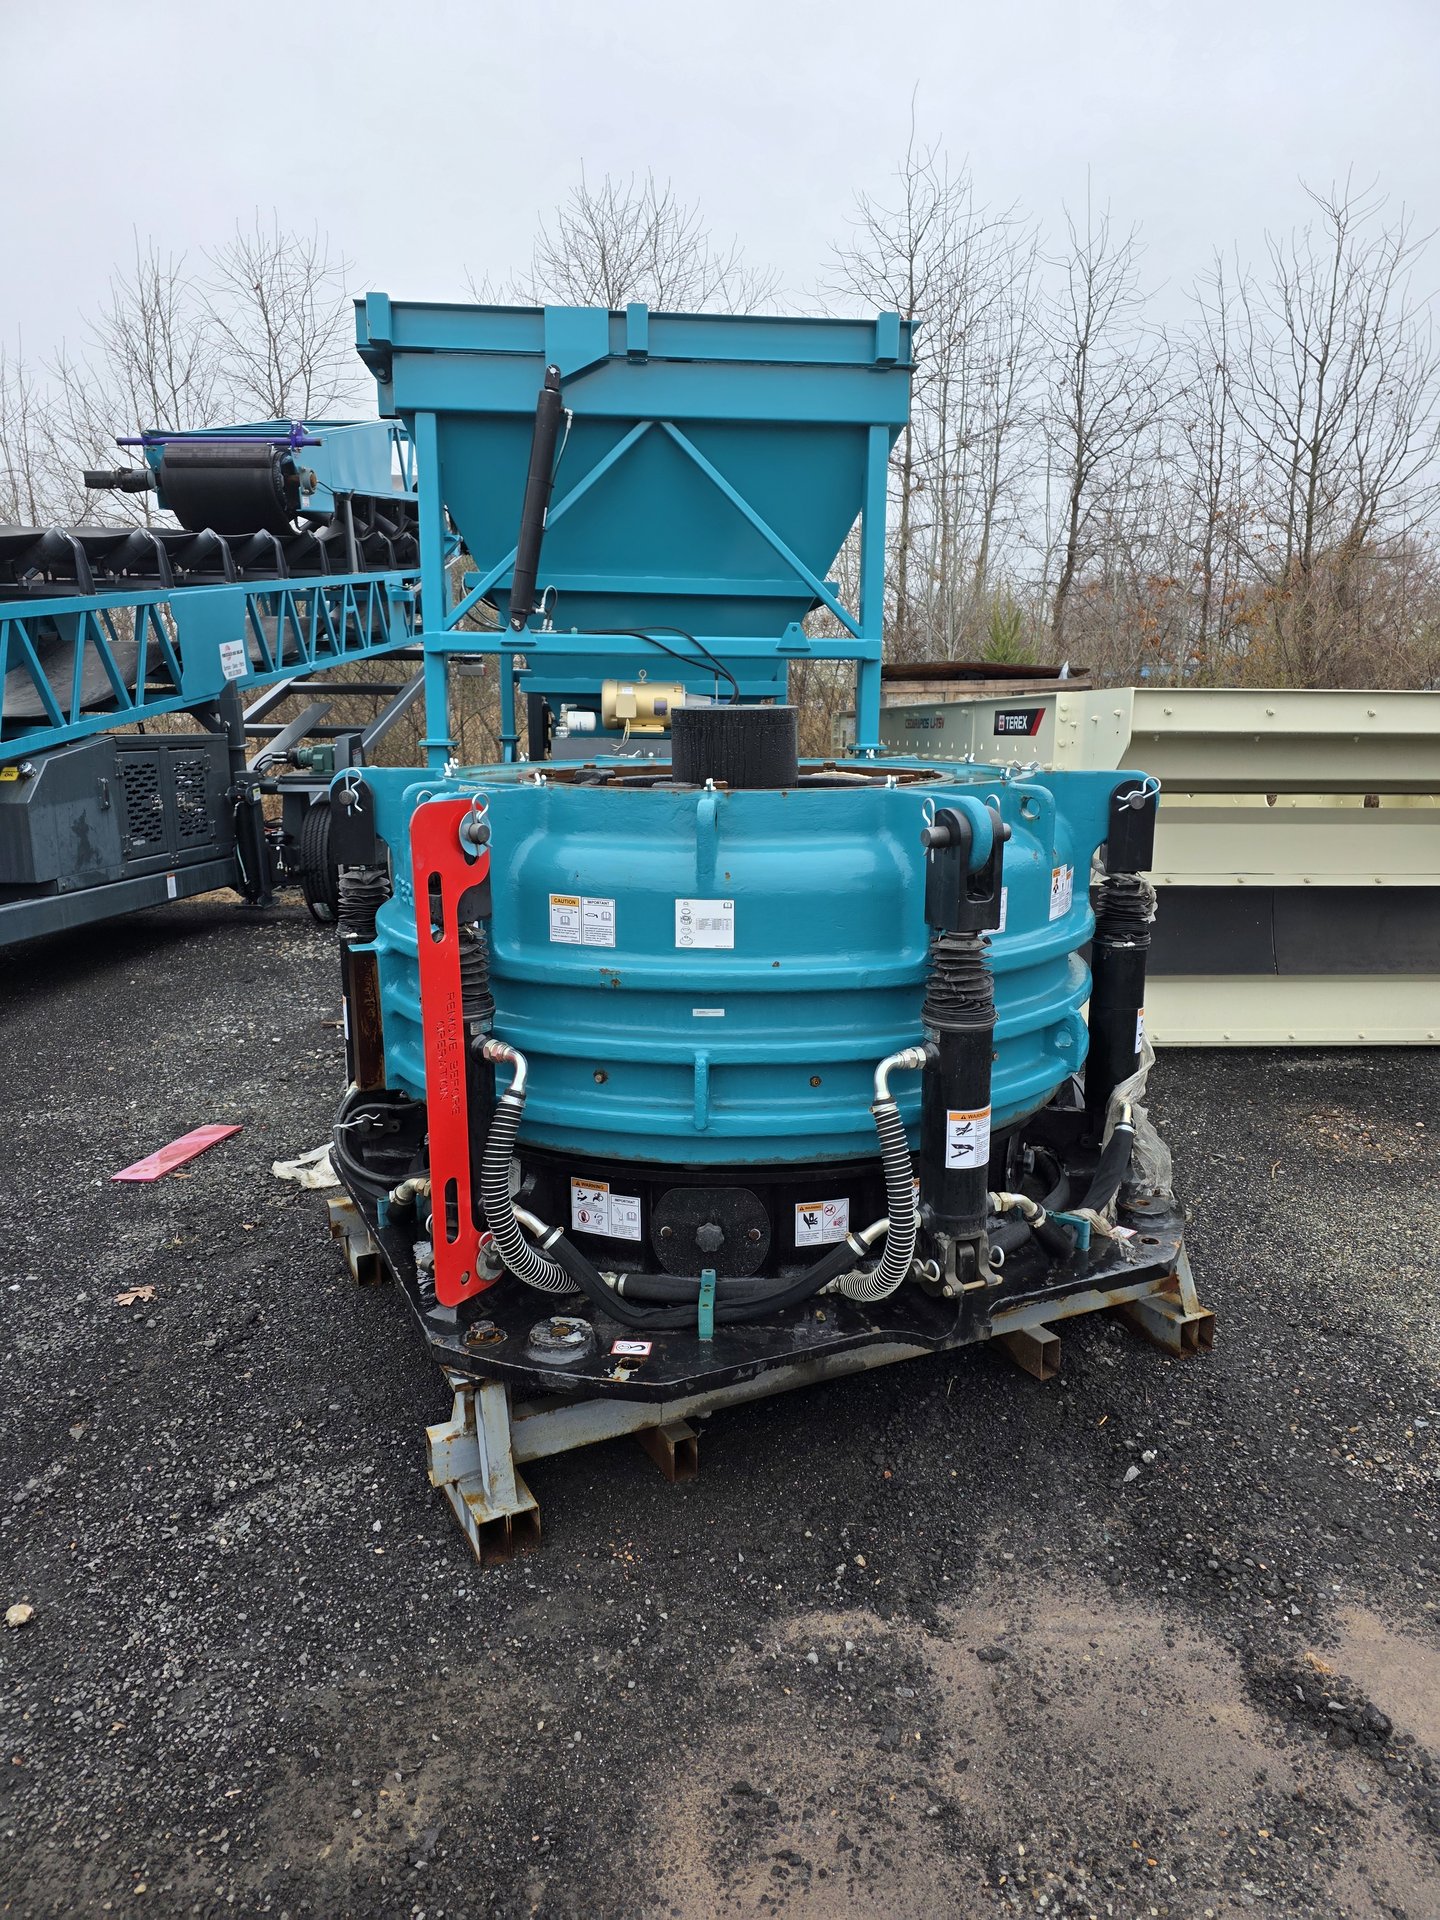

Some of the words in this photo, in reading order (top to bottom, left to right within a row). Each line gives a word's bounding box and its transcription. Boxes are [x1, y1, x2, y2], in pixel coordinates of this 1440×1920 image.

[1005, 715, 1028, 730] TEREX
[553, 897, 576, 905] CAUTION
[446, 991, 458, 1052] REMOVE
[435, 1020, 449, 1101] OPERATION
[449, 1060, 461, 1116] BEFORE
[581, 1181, 604, 1190] WARNING
